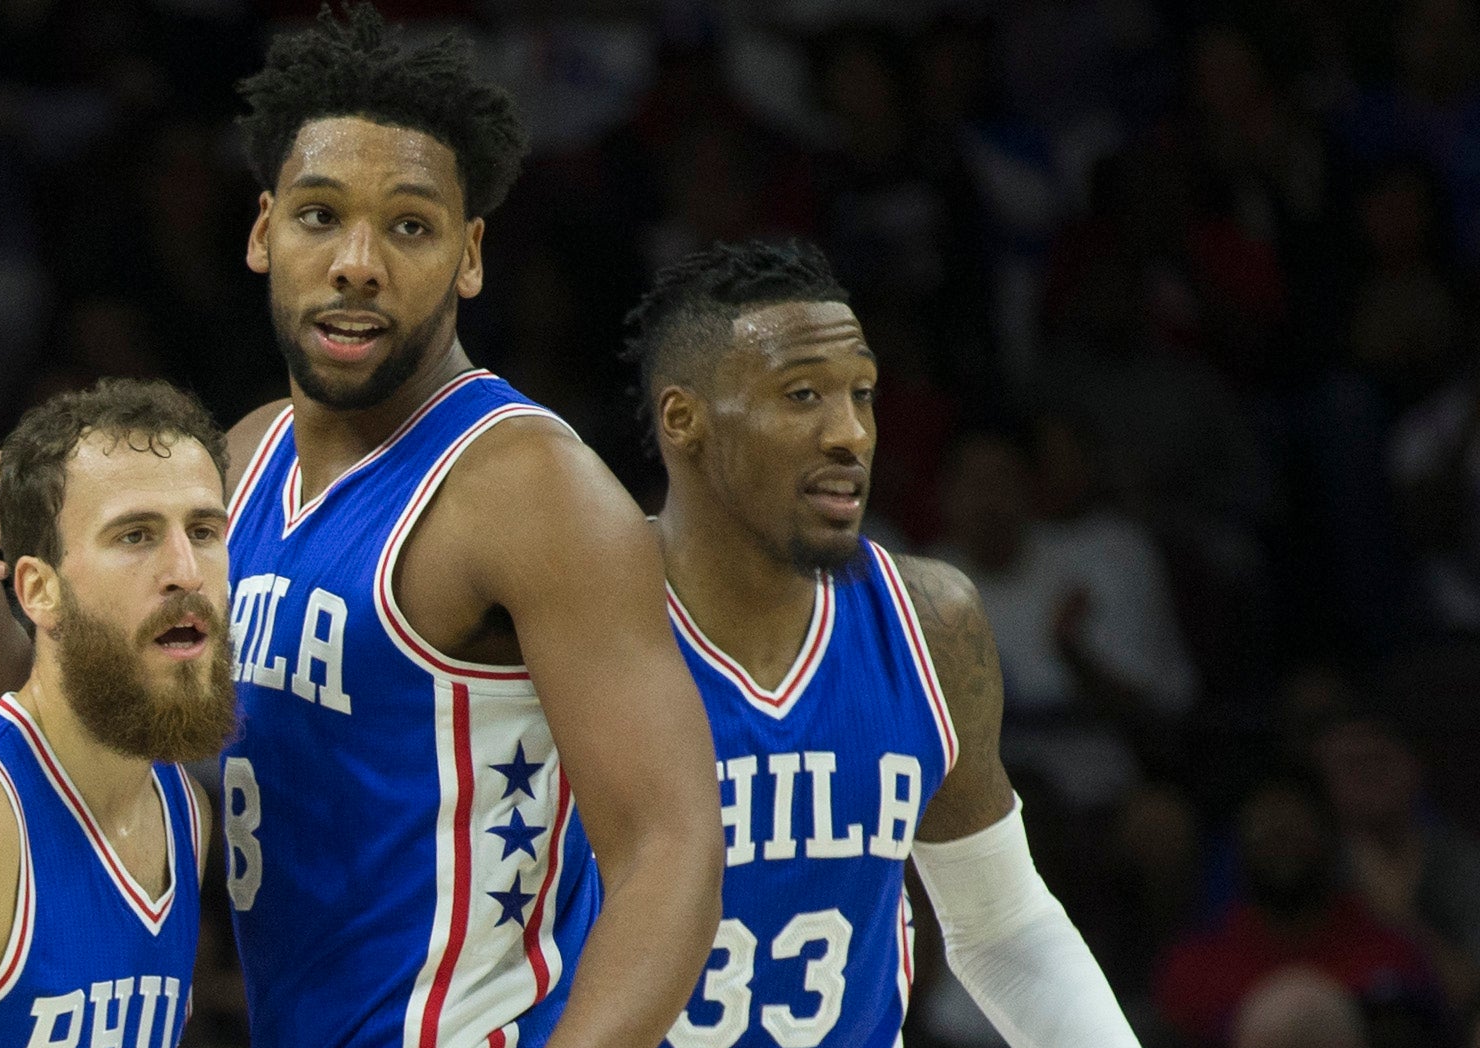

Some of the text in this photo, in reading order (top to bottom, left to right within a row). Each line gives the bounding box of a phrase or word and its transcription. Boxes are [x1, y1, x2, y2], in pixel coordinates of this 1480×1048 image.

[227, 573, 351, 715] HILA
[224, 757, 262, 911] 8
[715, 751, 922, 867] HILA
